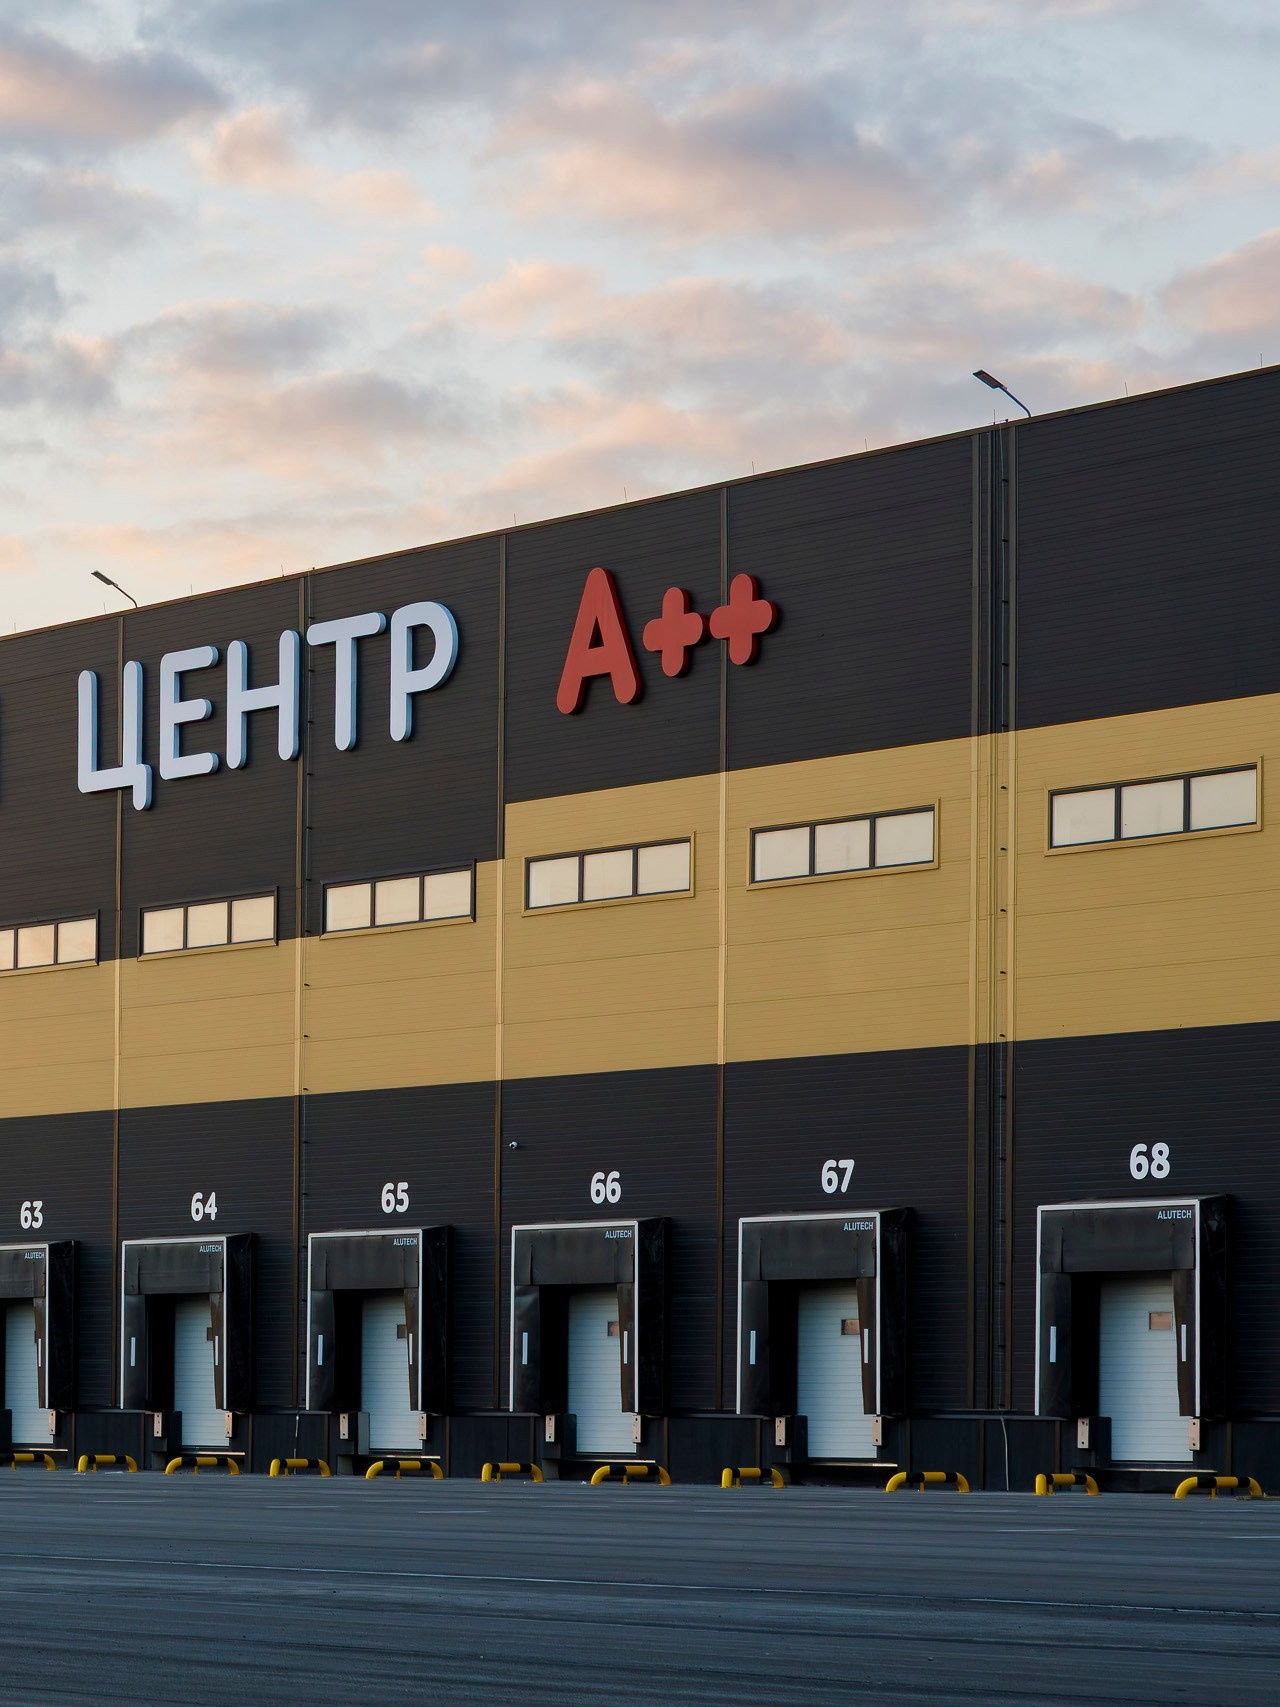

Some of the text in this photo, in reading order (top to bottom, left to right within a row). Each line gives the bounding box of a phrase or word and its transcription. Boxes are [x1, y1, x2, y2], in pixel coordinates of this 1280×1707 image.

[77, 600, 459, 811] ЦЕНТР
[1130, 1143, 1170, 1179] 68
[591, 1171, 622, 1204] 66
[822, 1159, 855, 1193] 67
[191, 1192, 217, 1221] 64
[381, 1182, 409, 1213] 65
[21, 1201, 43, 1229] 63
[843, 1222, 873, 1231] ALUTECH
[1157, 1210, 1191, 1219] ALUTECH
[200, 1244, 222, 1252] ALUTECH
[393, 1238, 417, 1246] ALUTECH
[605, 1230, 632, 1239] ALUTECH
[25, 1252, 44, 1260] ALUTECH
